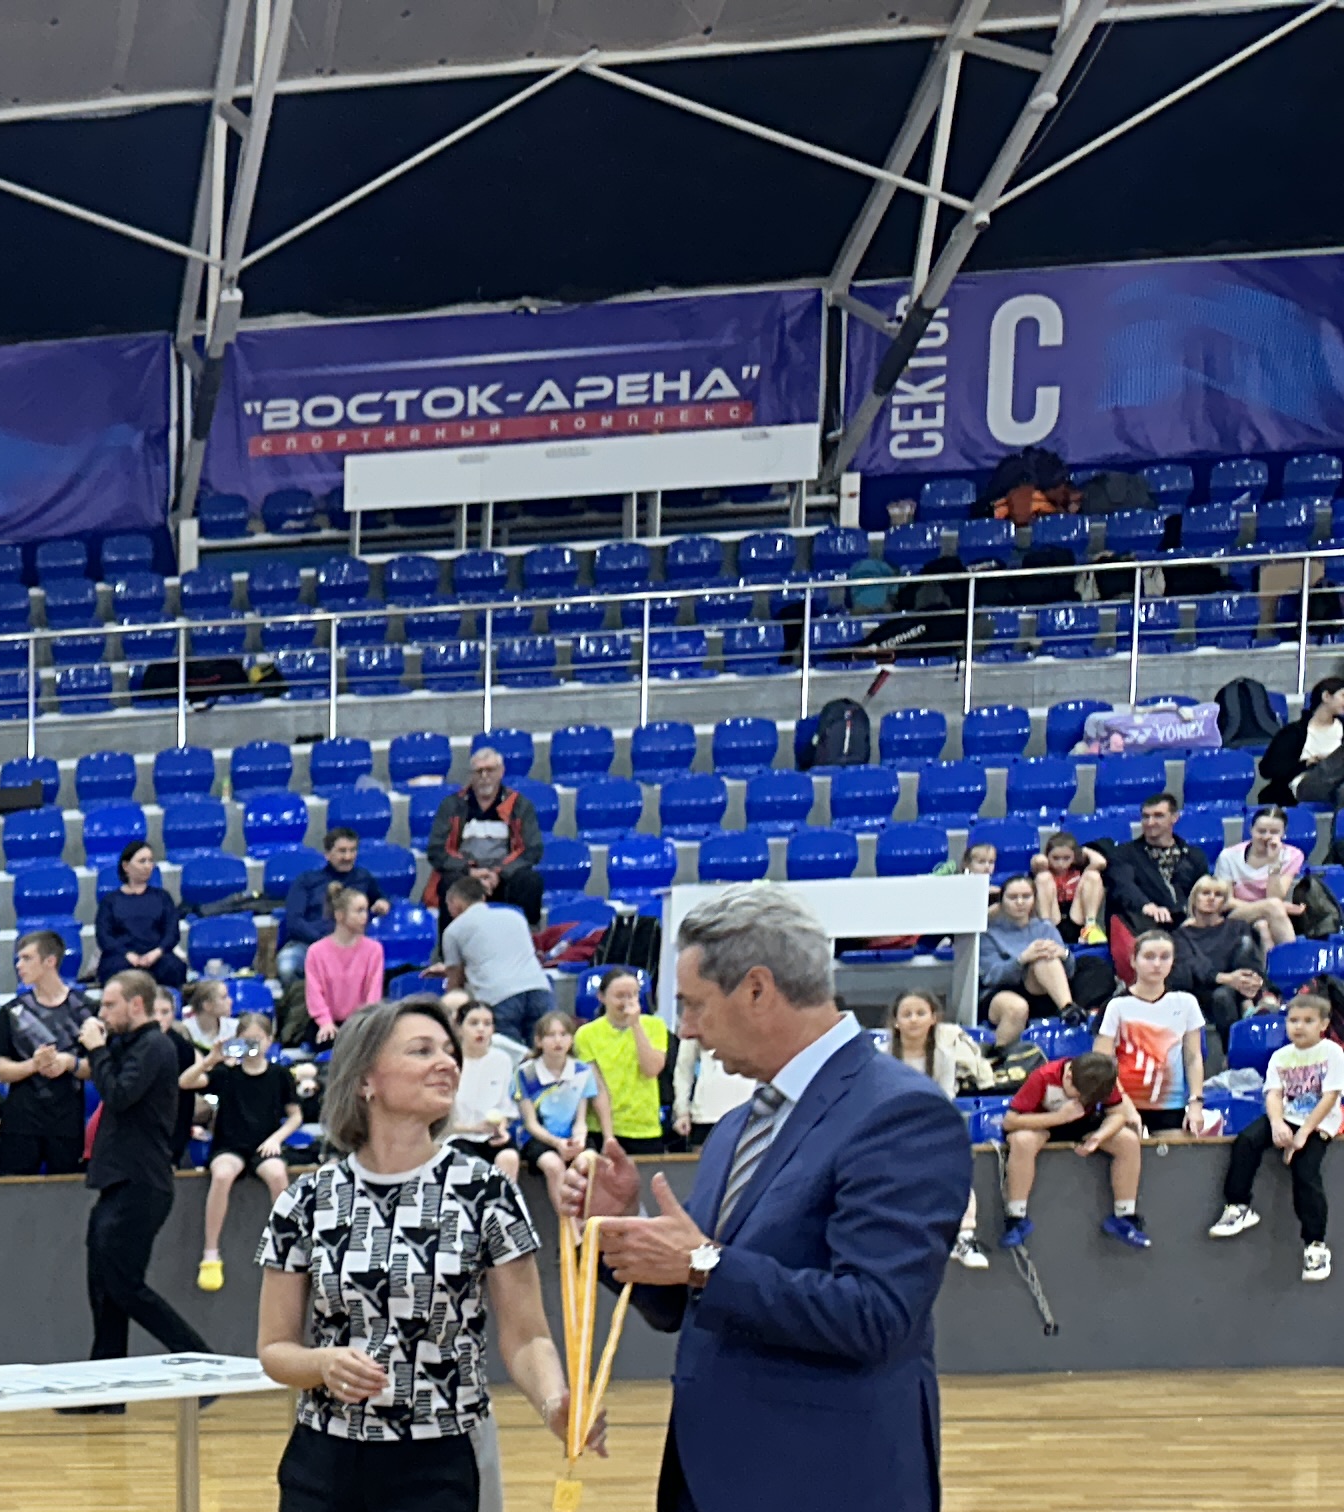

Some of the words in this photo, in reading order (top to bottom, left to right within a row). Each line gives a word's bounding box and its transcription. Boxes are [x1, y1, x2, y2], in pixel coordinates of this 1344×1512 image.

[244, 365, 760, 430] "ВОСТОК-АРЕНА"
[261, 422, 501, 452] СПОРТИВНЫЙ
[550, 406, 740, 432] КОМПЛЕКС
